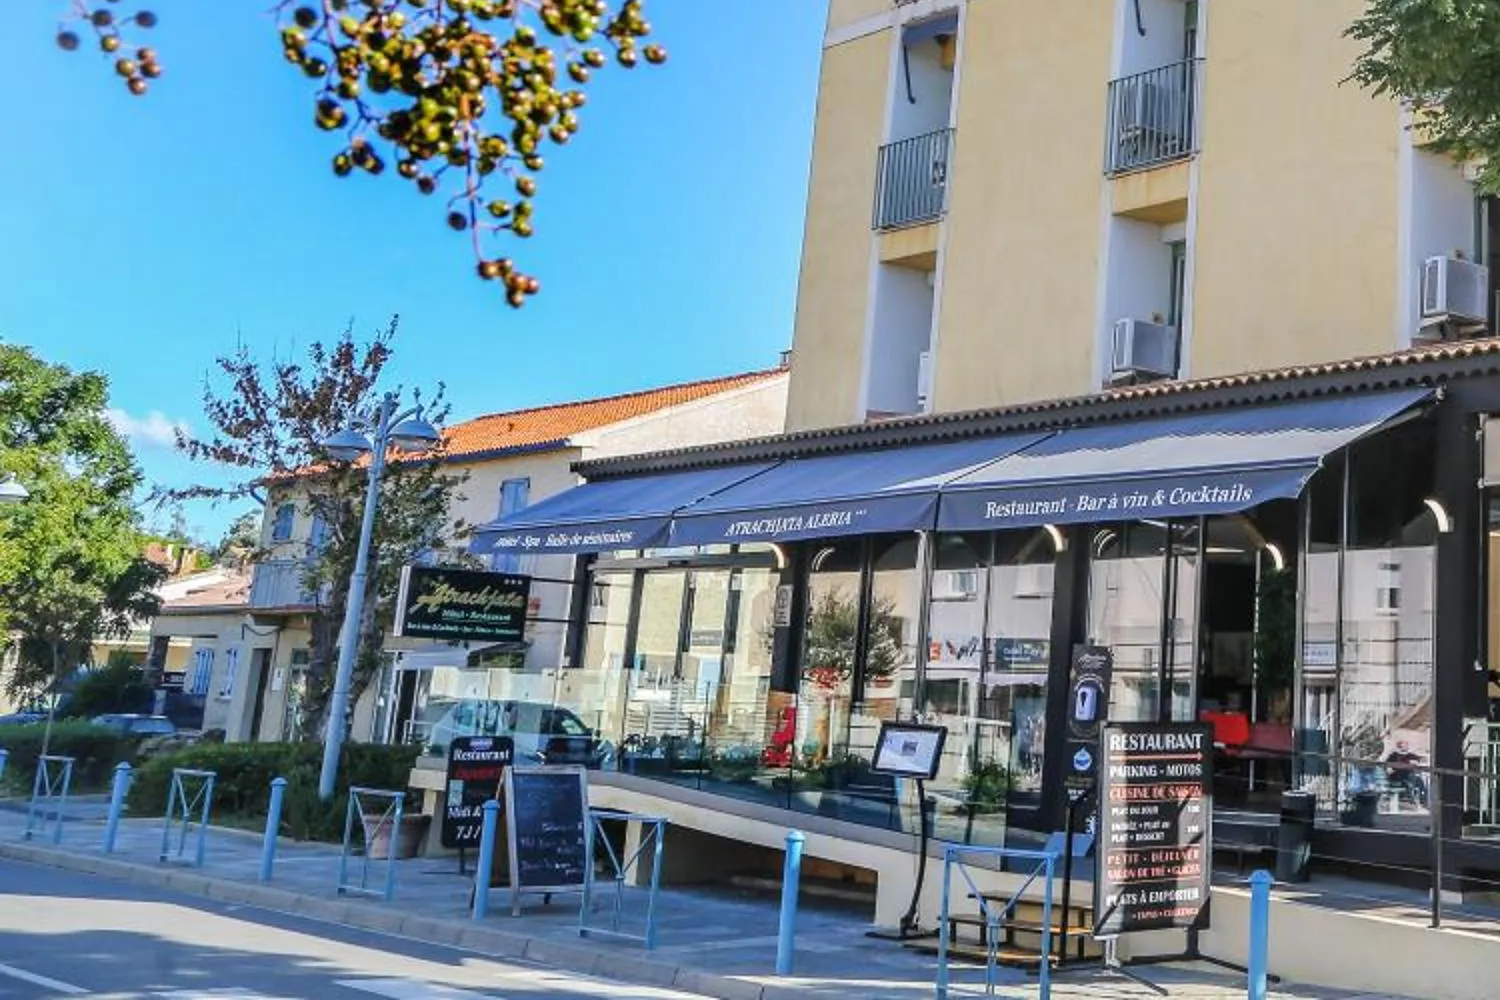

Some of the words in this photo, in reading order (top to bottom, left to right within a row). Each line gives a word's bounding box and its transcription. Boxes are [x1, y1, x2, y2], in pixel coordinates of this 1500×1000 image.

[985, 497, 1067, 519] Restaurant
[1076, 494, 1107, 512] Bar
[1107, 492, 1118, 509] à
[1122, 490, 1149, 509] vin
[1151, 488, 1167, 507] &
[1169, 483, 1254, 506] Cocktails
[803, 510, 851, 529] ALERIA
[1110, 733, 1204, 751] RESTAURANT
[453, 749, 510, 761] Restaurant
[1109, 764, 1157, 777] PARKING
[1166, 763, 1203, 777] MOTOS
